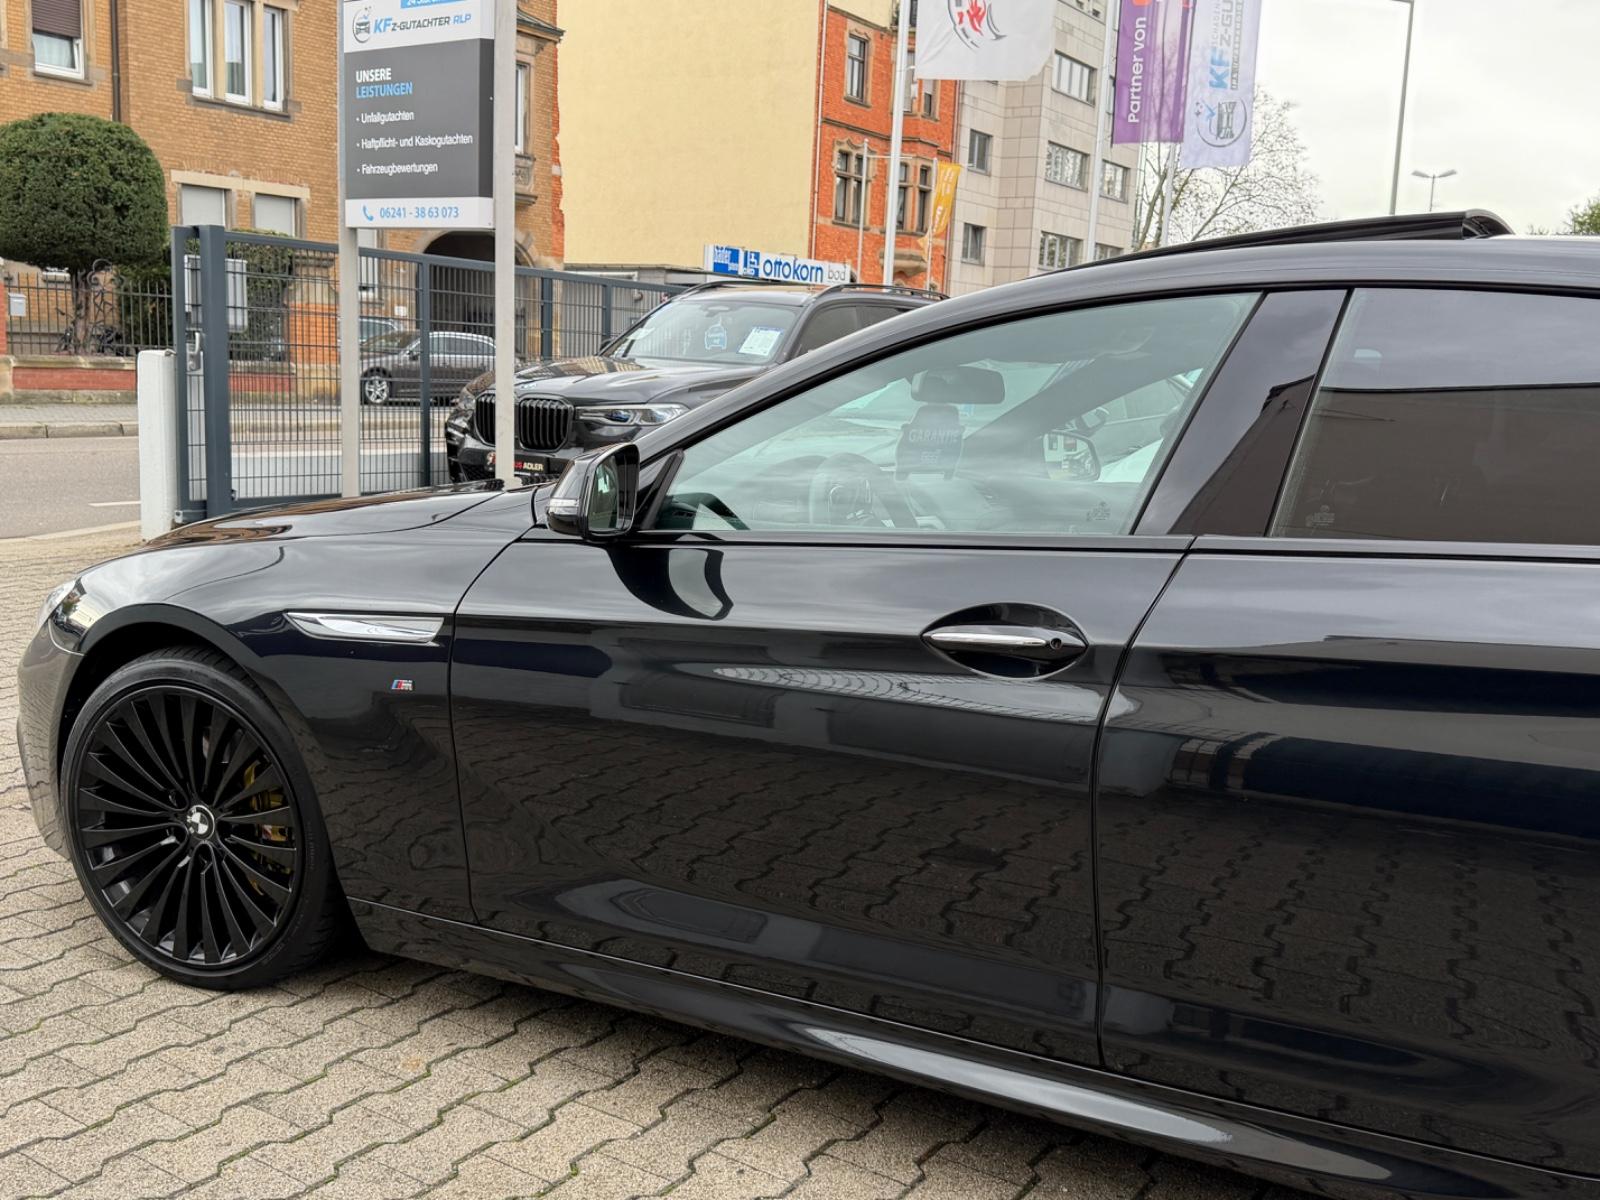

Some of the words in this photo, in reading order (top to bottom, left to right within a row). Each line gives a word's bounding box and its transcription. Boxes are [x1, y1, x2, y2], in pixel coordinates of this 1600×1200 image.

[1133, 16, 1147, 52] von
[355, 67, 392, 83] UNSERE
[356, 81, 413, 99] LEISTUNGEN
[1128, 55, 1144, 123] Partner
[361, 110, 415, 125] Unfallgutachten
[361, 137, 398, 151] Haftpflicht-
[399, 136, 414, 148] und
[414, 133, 473, 148] Kaskogutachten
[361, 163, 438, 176] Fahrzeugbewertungen
[379, 207, 407, 219] 06241
[414, 207, 426, 219] 38
[427, 206, 440, 219] 63
[441, 206, 459, 219] 073
